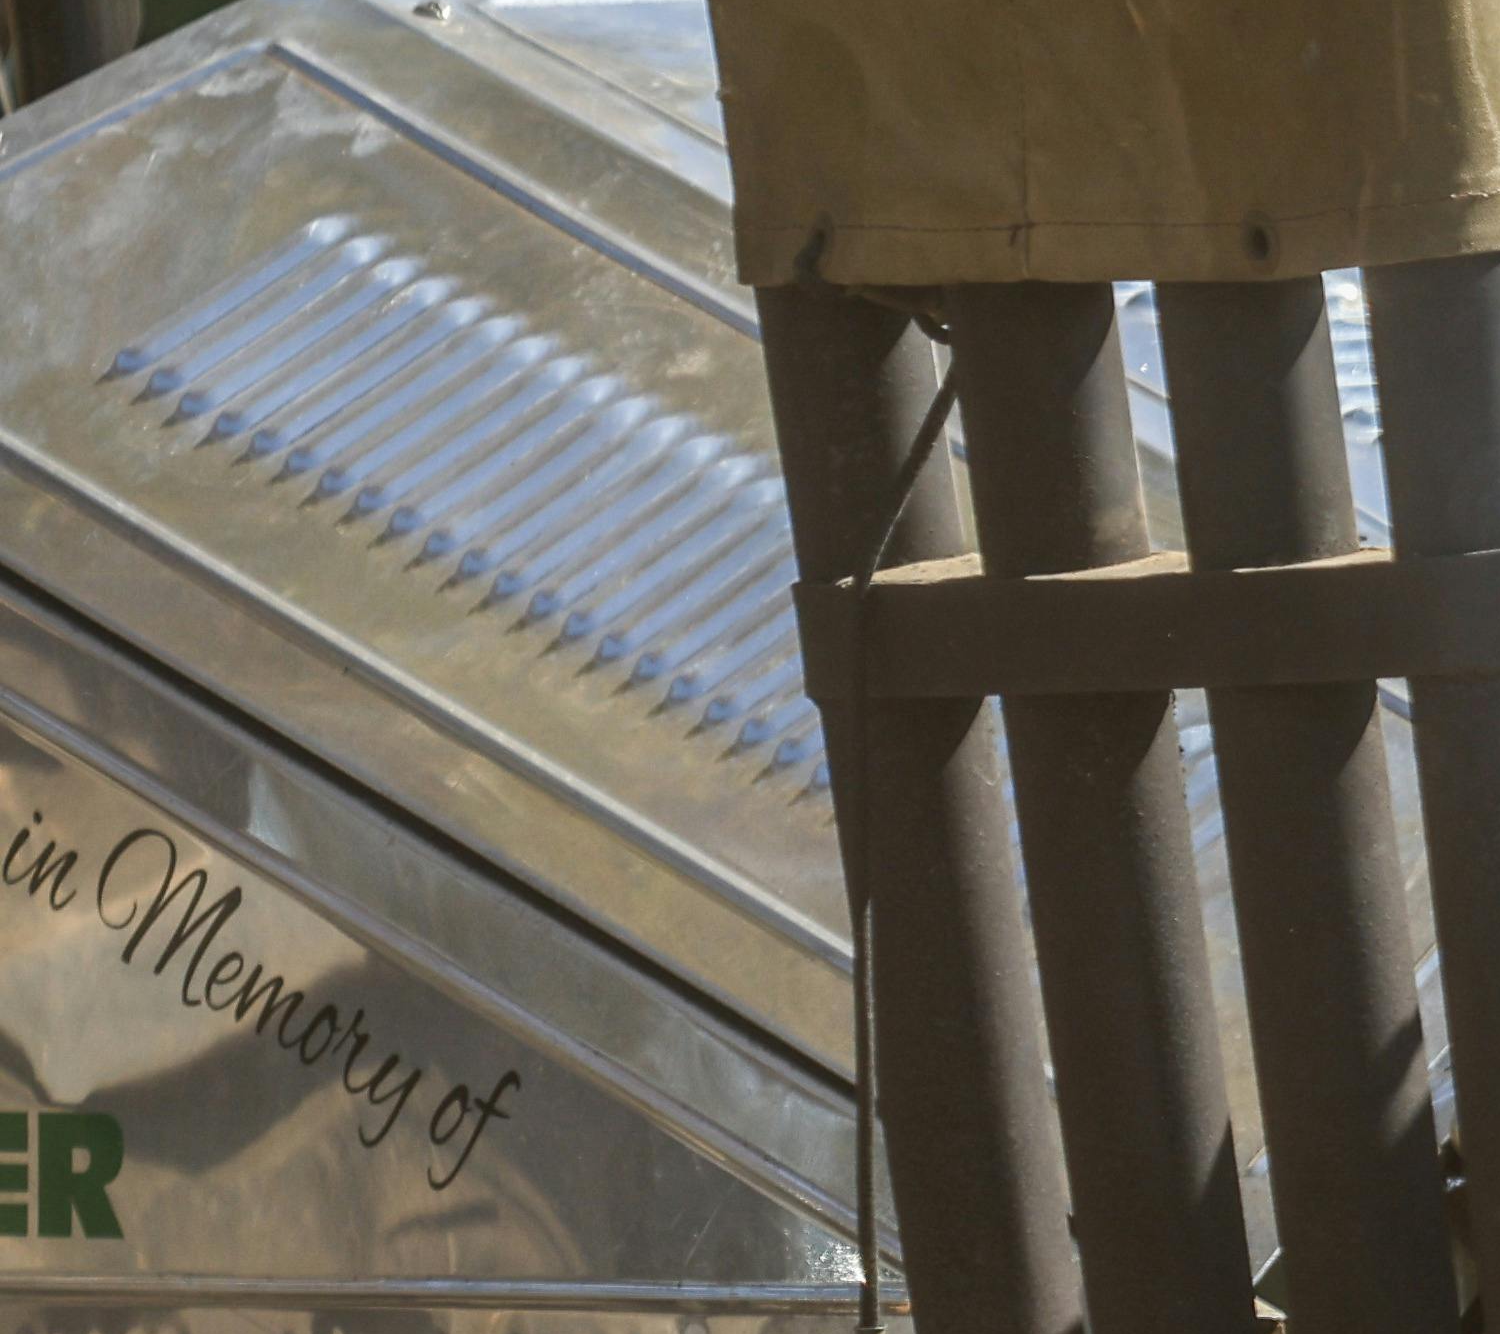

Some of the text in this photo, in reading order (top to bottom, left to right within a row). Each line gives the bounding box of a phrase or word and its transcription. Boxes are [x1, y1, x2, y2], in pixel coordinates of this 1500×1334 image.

[2, 810, 520, 1191] in Memory of
